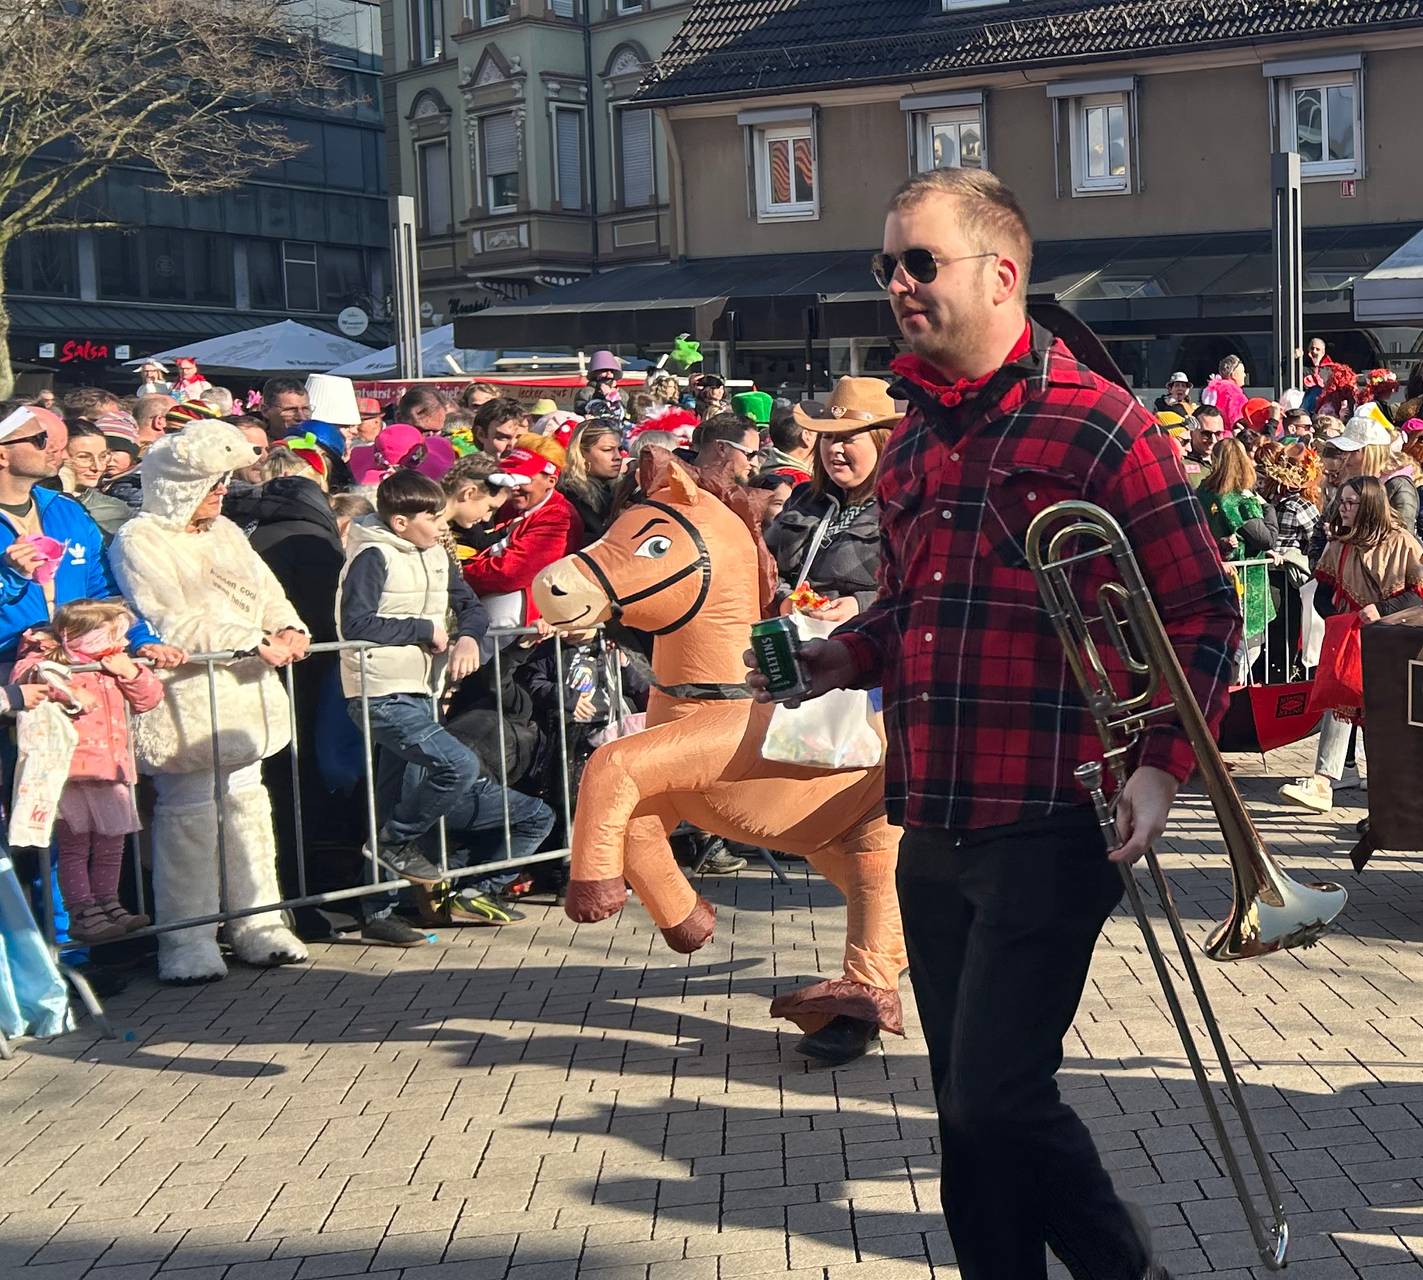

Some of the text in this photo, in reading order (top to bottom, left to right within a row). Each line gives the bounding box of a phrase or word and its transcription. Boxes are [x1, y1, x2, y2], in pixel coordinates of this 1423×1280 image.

[59, 340, 108, 363] Salsa
[239, 586, 257, 601] cool
[761, 637, 782, 681] VELTINS
